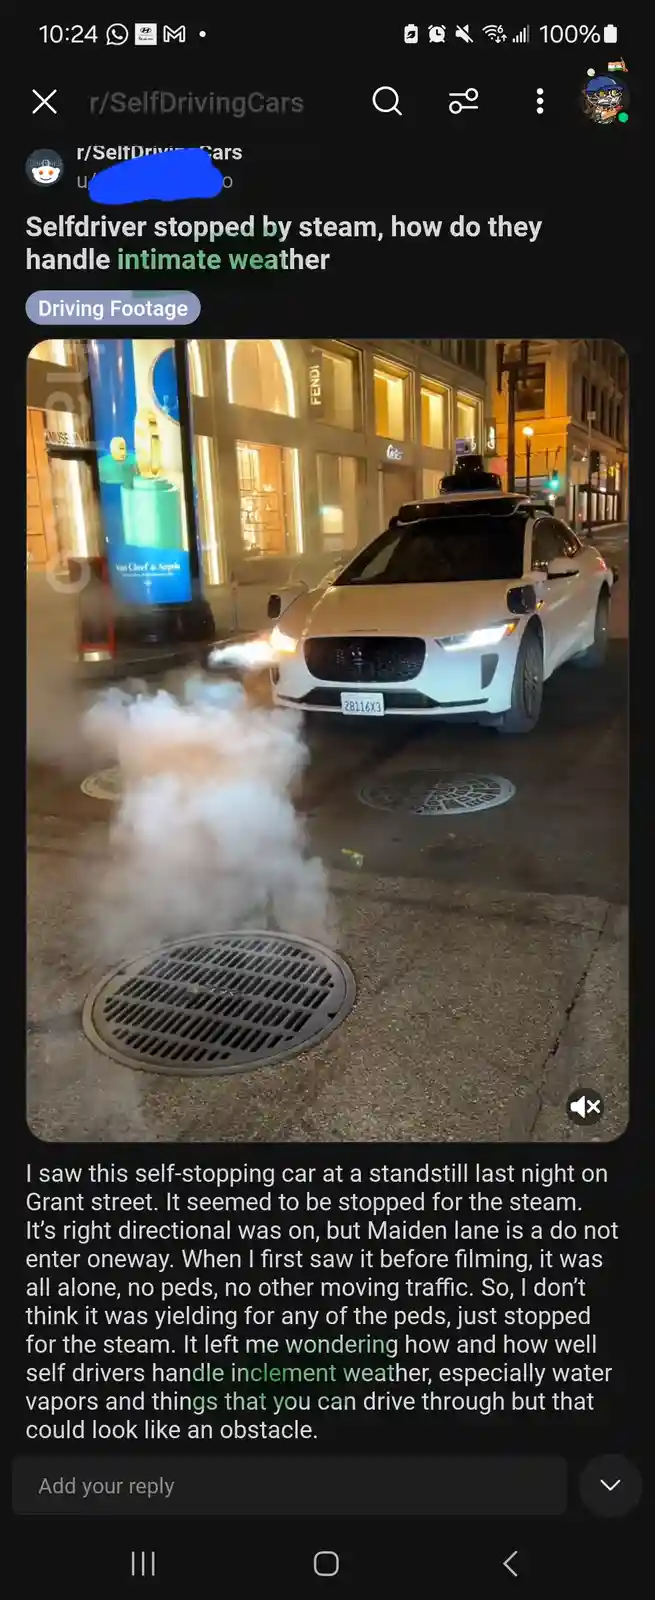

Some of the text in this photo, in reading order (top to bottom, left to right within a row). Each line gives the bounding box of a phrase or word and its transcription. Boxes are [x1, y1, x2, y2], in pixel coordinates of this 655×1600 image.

[39, 24, 99, 44] 10:24
[539, 24, 601, 44] 100%
[89, 90, 305, 119] r/SelfDrivingCars
[25, 214, 543, 243] Selfdriver stopped by steam, how do they
[26, 247, 331, 270] handle intimate weather
[38, 299, 188, 321] Driving Footage
[309, 364, 322, 406] FENDI
[26, 1162, 608, 1188] I saw this self-stopping car at a standstill last night on
[26, 1191, 582, 1216] Grant street. It seemed to be stopped for the steam.
[63, 1219, 112, 1245] right
[118, 1219, 231, 1240] directional
[237, 1224, 282, 1240] was
[288, 1224, 320, 1243] on,
[326, 1219, 361, 1240] but
[368, 1219, 447, 1240] Maiden
[454, 1219, 500, 1240] lane
[506, 1219, 524, 1240] is
[530, 1224, 543, 1240] a
[549, 1219, 577, 1240] do
[584, 1221, 619, 1240] not
[25, 1248, 603, 1273] enter oneway. When I first saw it before filming, it was
[26, 1276, 50, 1297] all
[57, 1276, 121, 1300] alone,
[128, 1281, 155, 1297] no
[161, 1276, 218, 1302] peds,
[225, 1281, 252, 1297] no
[258, 1276, 315, 1297] other
[321, 1276, 399, 1302] moving
[405, 1276, 474, 1297] traffic.
[481, 1277, 514, 1300] So,
[521, 1277, 526, 1297] I
[24, 1305, 591, 1330] think it was yielding for any of the peds, just stopped
[25, 1333, 597, 1359] for the steam. It left me wondering how and how well
[26, 1362, 613, 1387] self drivers handle inclement weather, especially water
[25, 1390, 595, 1416] vapors and things that you can drive through but that
[25, 1419, 318, 1440] could look like an obstacle.
[38, 1476, 175, 1499] Add your reply
